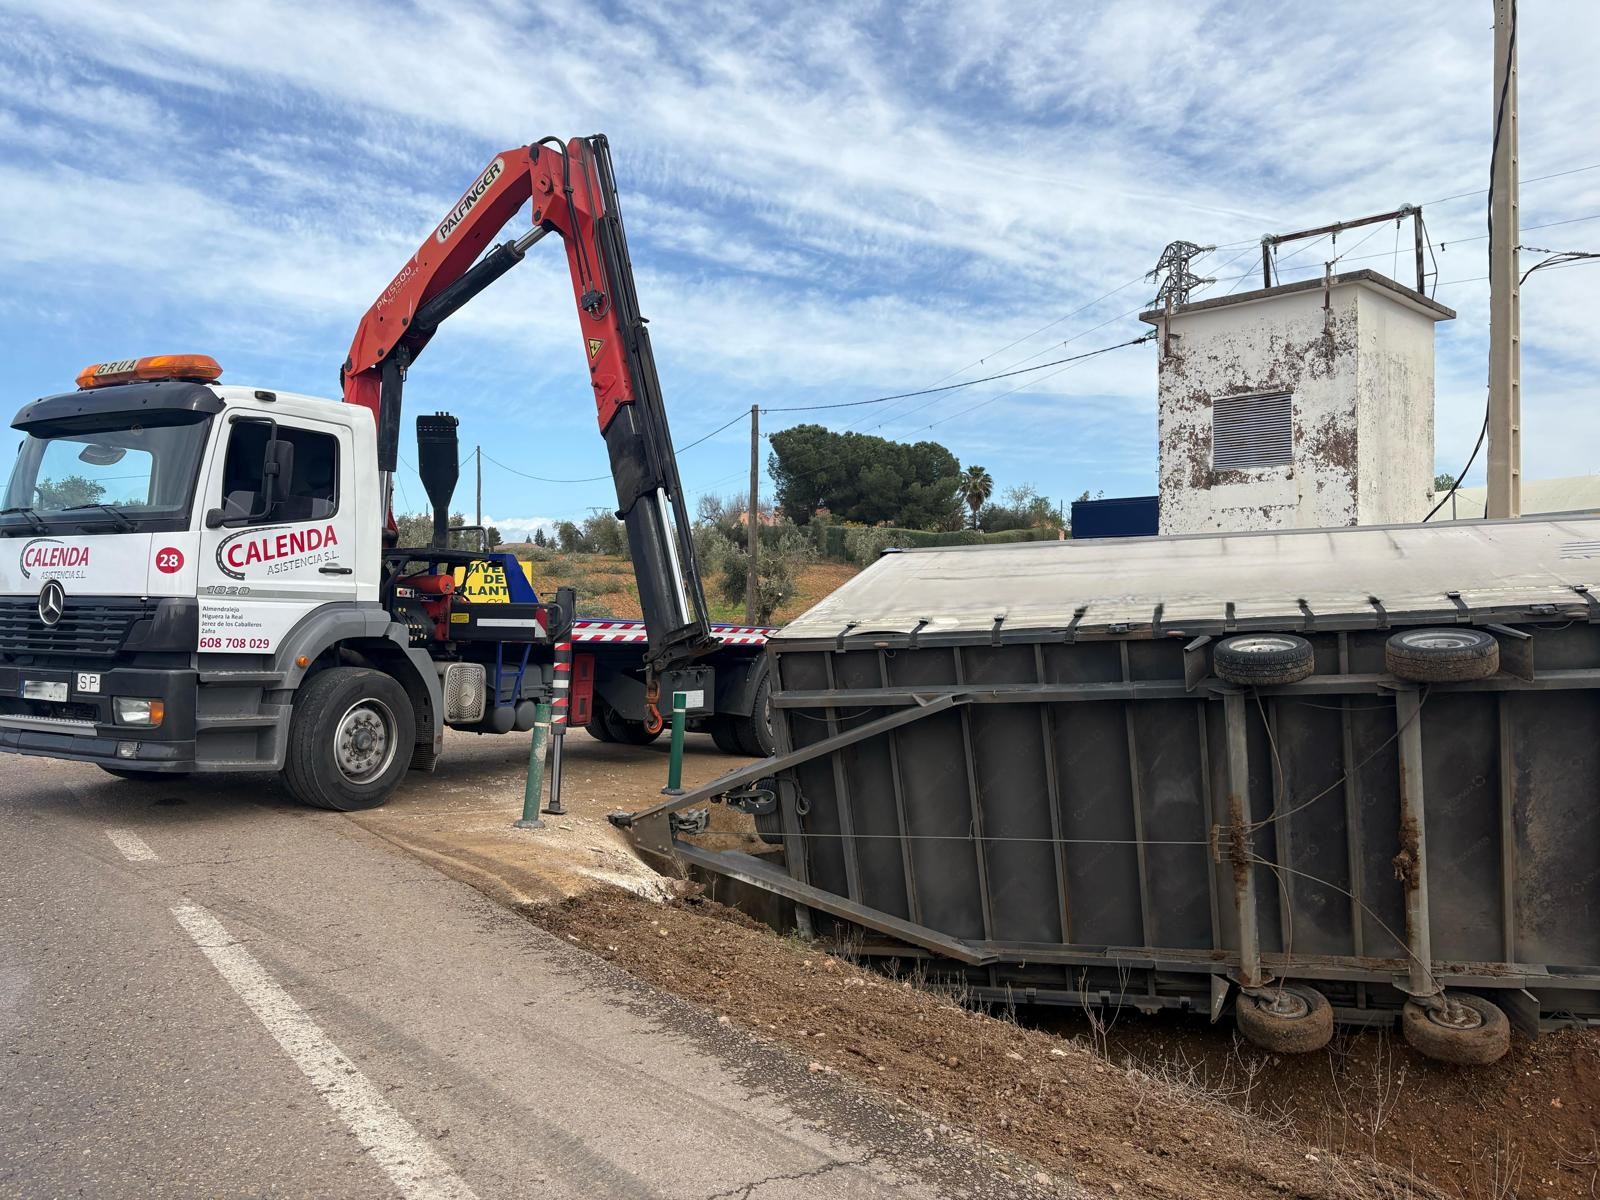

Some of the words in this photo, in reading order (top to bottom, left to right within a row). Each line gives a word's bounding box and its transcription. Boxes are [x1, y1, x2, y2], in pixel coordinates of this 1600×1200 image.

[440, 163, 500, 239] PALFINGER
[97, 359, 136, 374] GRUA
[227, 525, 338, 567] CALENDA
[25, 547, 89, 567] CALENDA
[159, 554, 179, 567] 28
[266, 553, 323, 575] ASISTENCIA
[40, 570, 75, 580] ASISTENCIA
[483, 574, 504, 584] DE
[200, 637, 222, 648] 608
[225, 638, 246, 648] 708
[249, 638, 270, 649] 029
[80, 675, 97, 690] SP
